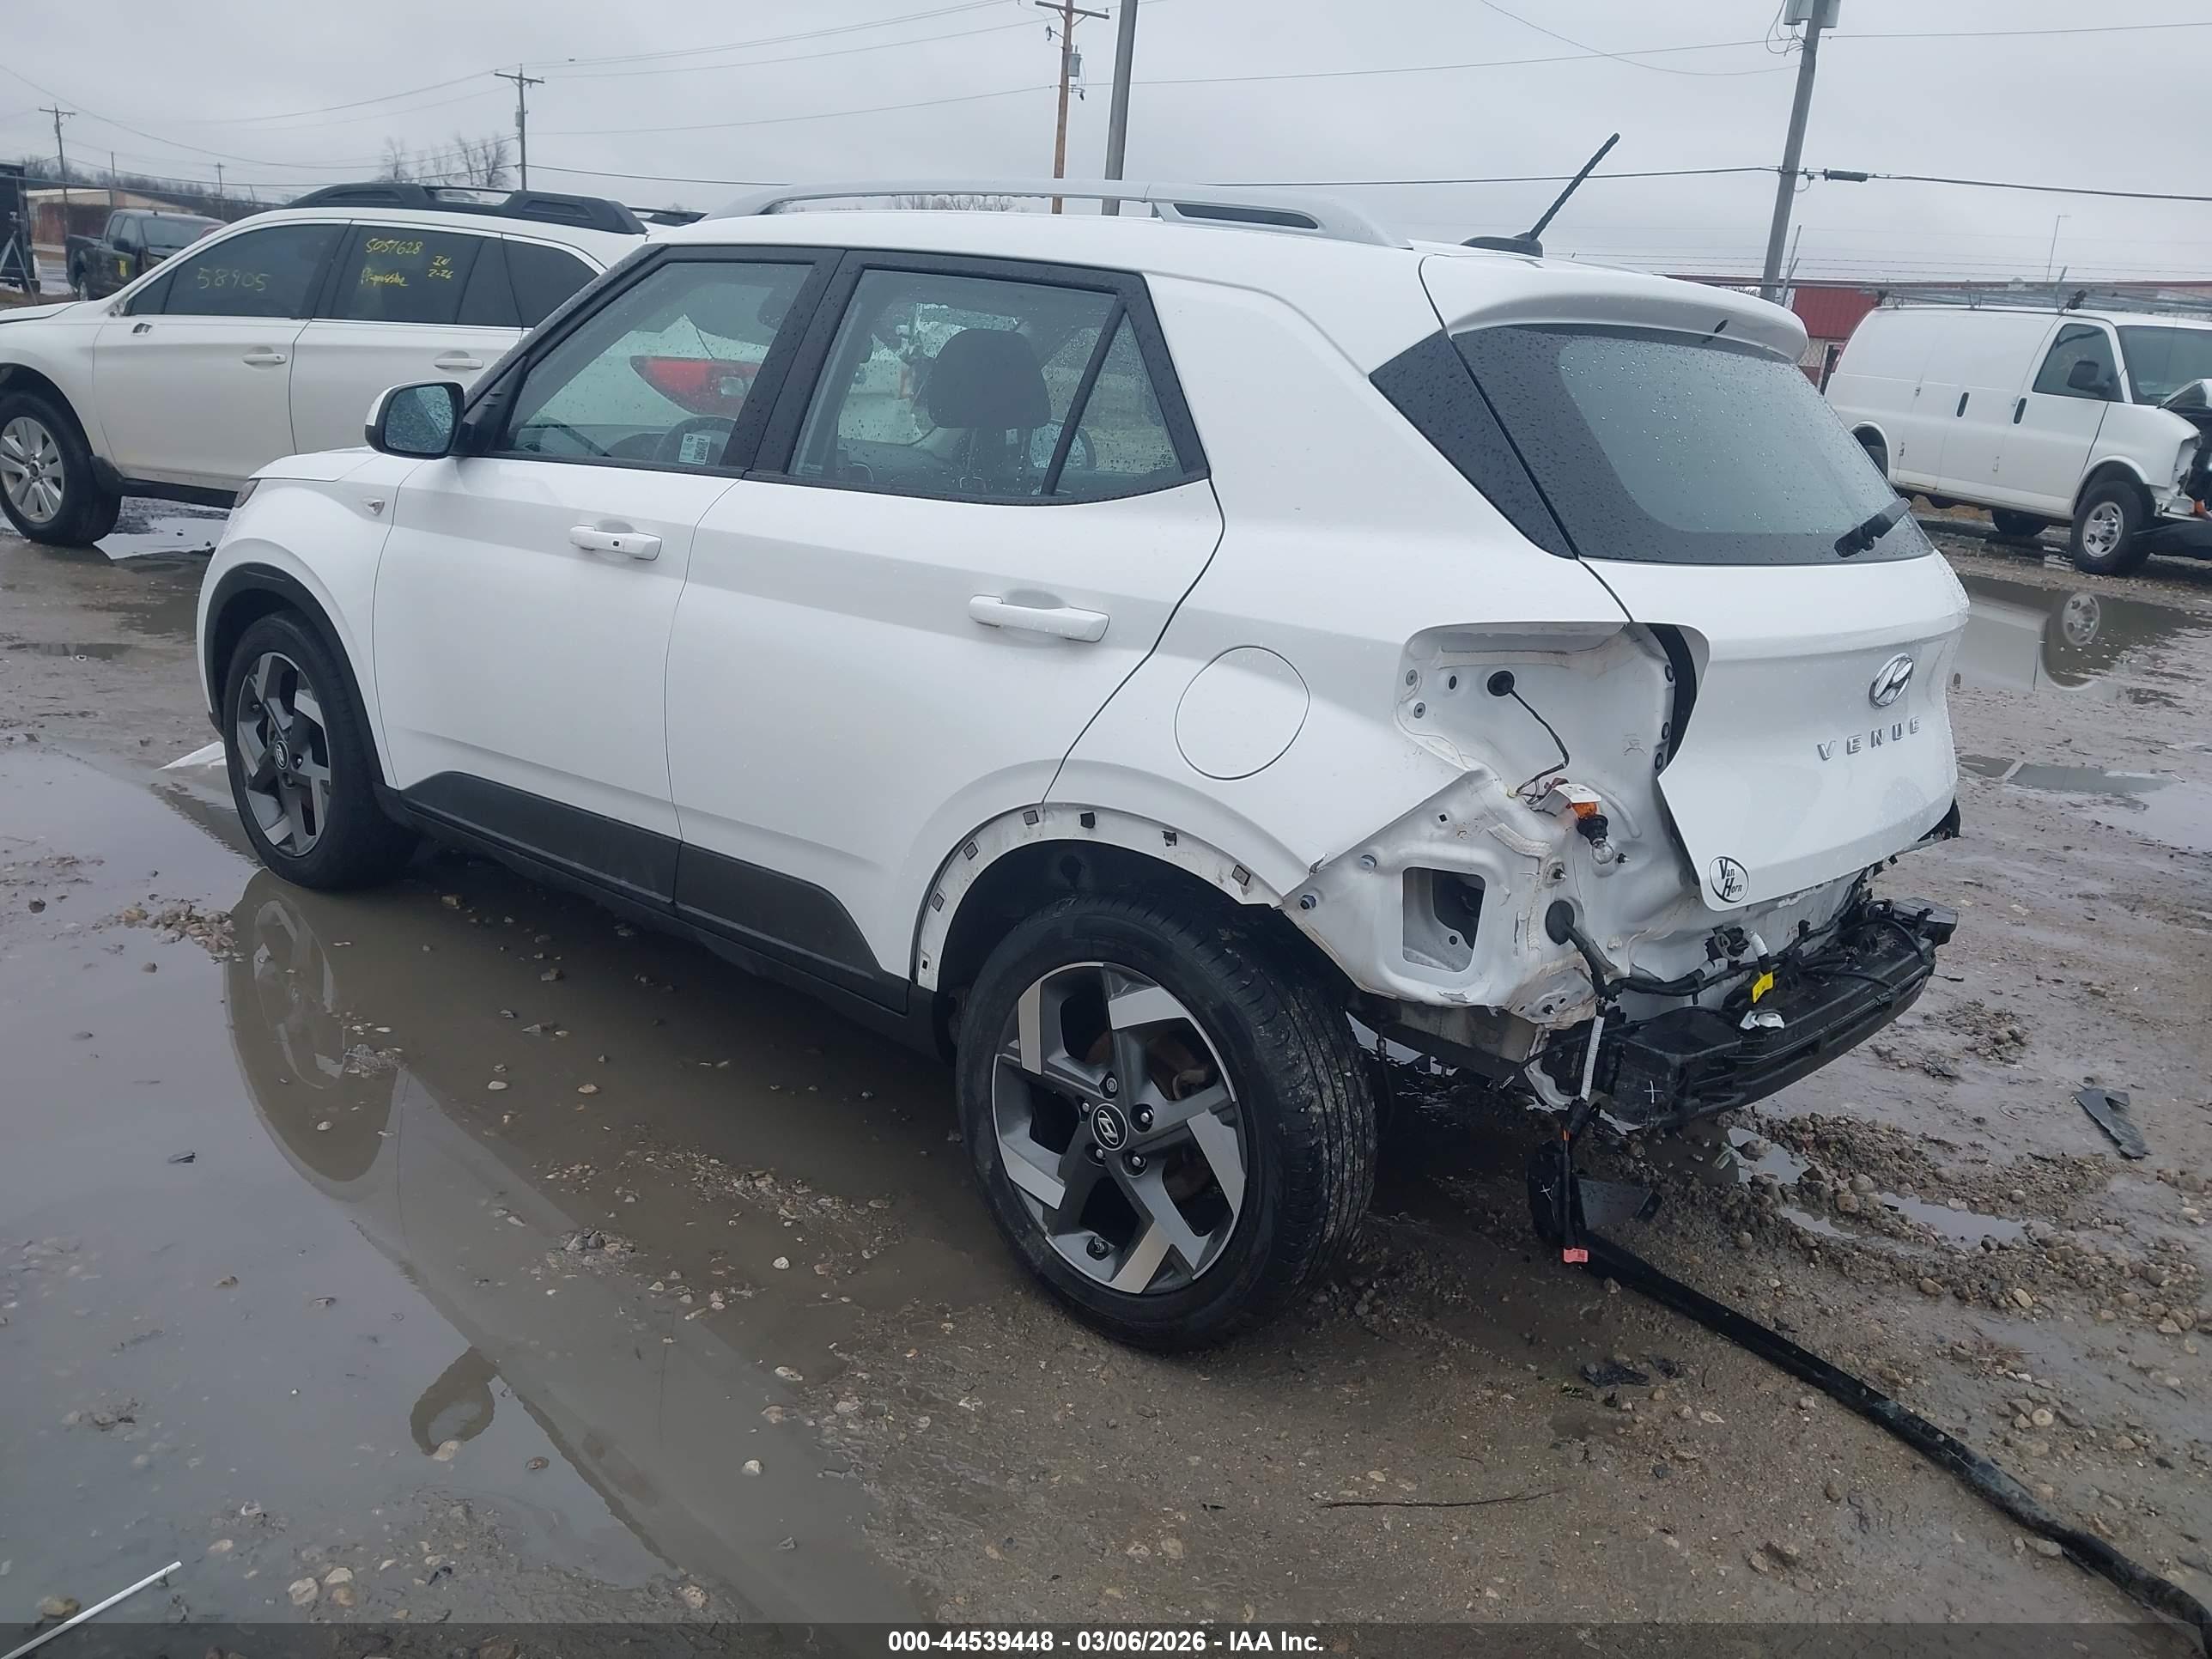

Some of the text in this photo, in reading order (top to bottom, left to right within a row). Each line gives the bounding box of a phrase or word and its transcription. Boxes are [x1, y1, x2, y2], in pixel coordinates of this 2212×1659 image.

[1816, 716, 1921, 762] VENUE
[1718, 859, 1735, 880] Van
[1722, 877, 1743, 898] Horn
